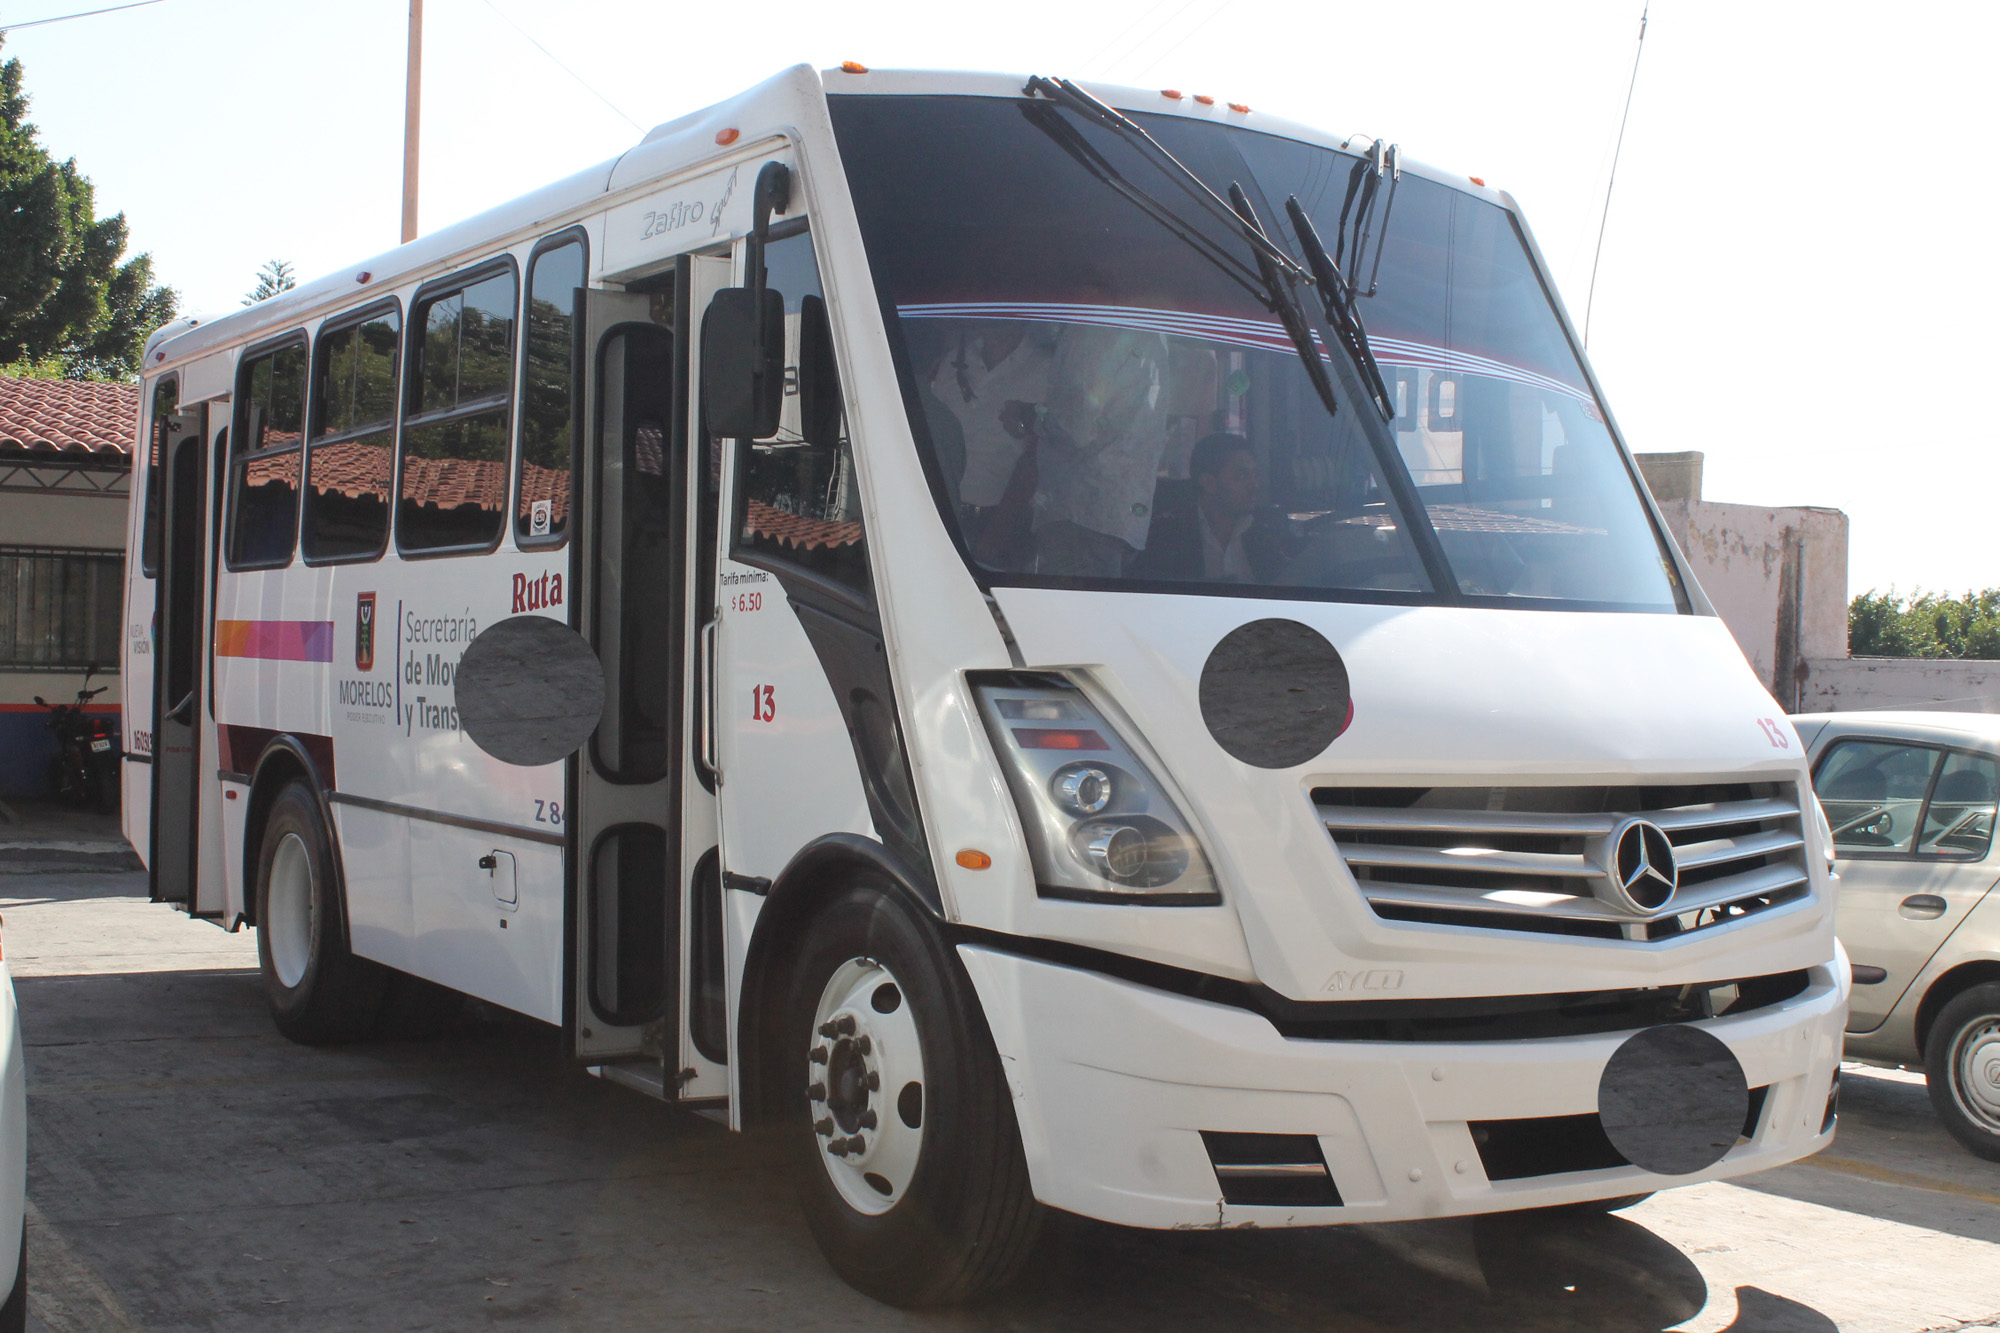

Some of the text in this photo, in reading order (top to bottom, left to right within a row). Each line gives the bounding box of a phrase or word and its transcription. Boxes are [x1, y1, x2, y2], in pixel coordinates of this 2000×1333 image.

[640, 201, 704, 240] Zafiro
[511, 569, 563, 614] Ruta
[720, 573, 739, 586] Tarifa
[732, 592, 762, 612] $ 6.50
[405, 606, 477, 643] Secretaría
[405, 650, 464, 686] de Mov
[339, 680, 393, 708] MORELOS
[753, 683, 776, 723] 13
[405, 703, 414, 737] y
[1756, 718, 1789, 749] 13
[534, 799, 547, 823] Z
